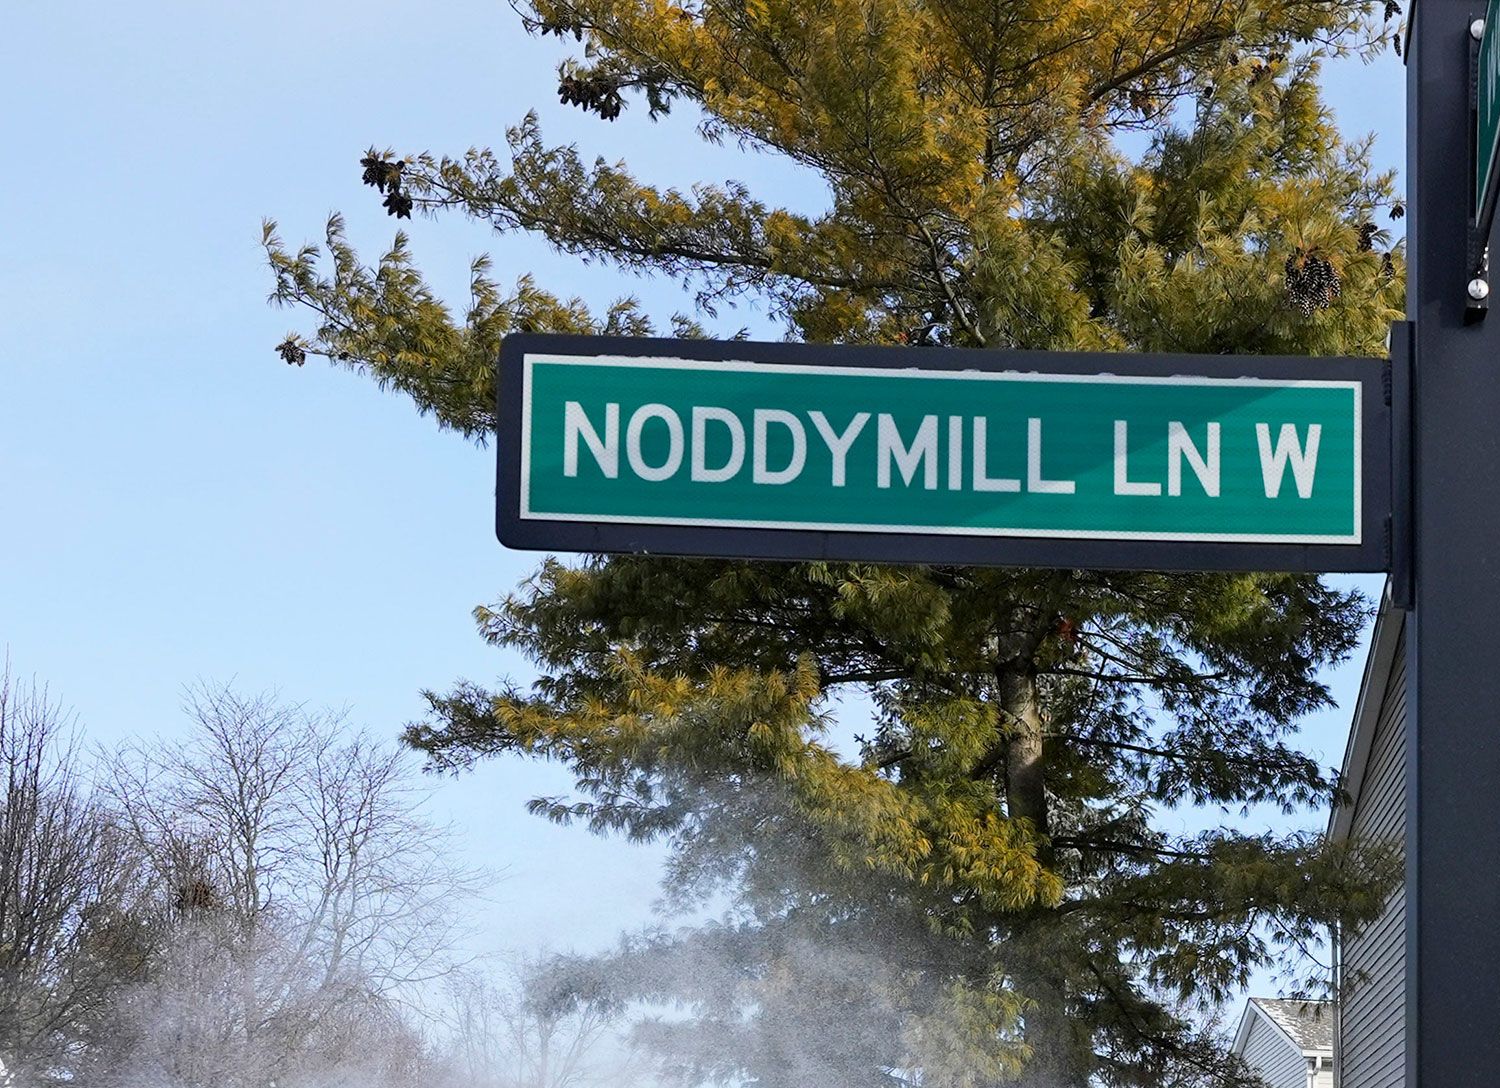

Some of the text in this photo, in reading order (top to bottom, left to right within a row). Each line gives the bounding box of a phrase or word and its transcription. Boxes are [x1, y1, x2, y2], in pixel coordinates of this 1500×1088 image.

[563, 401, 1322, 499] NODDYMILL LN W
